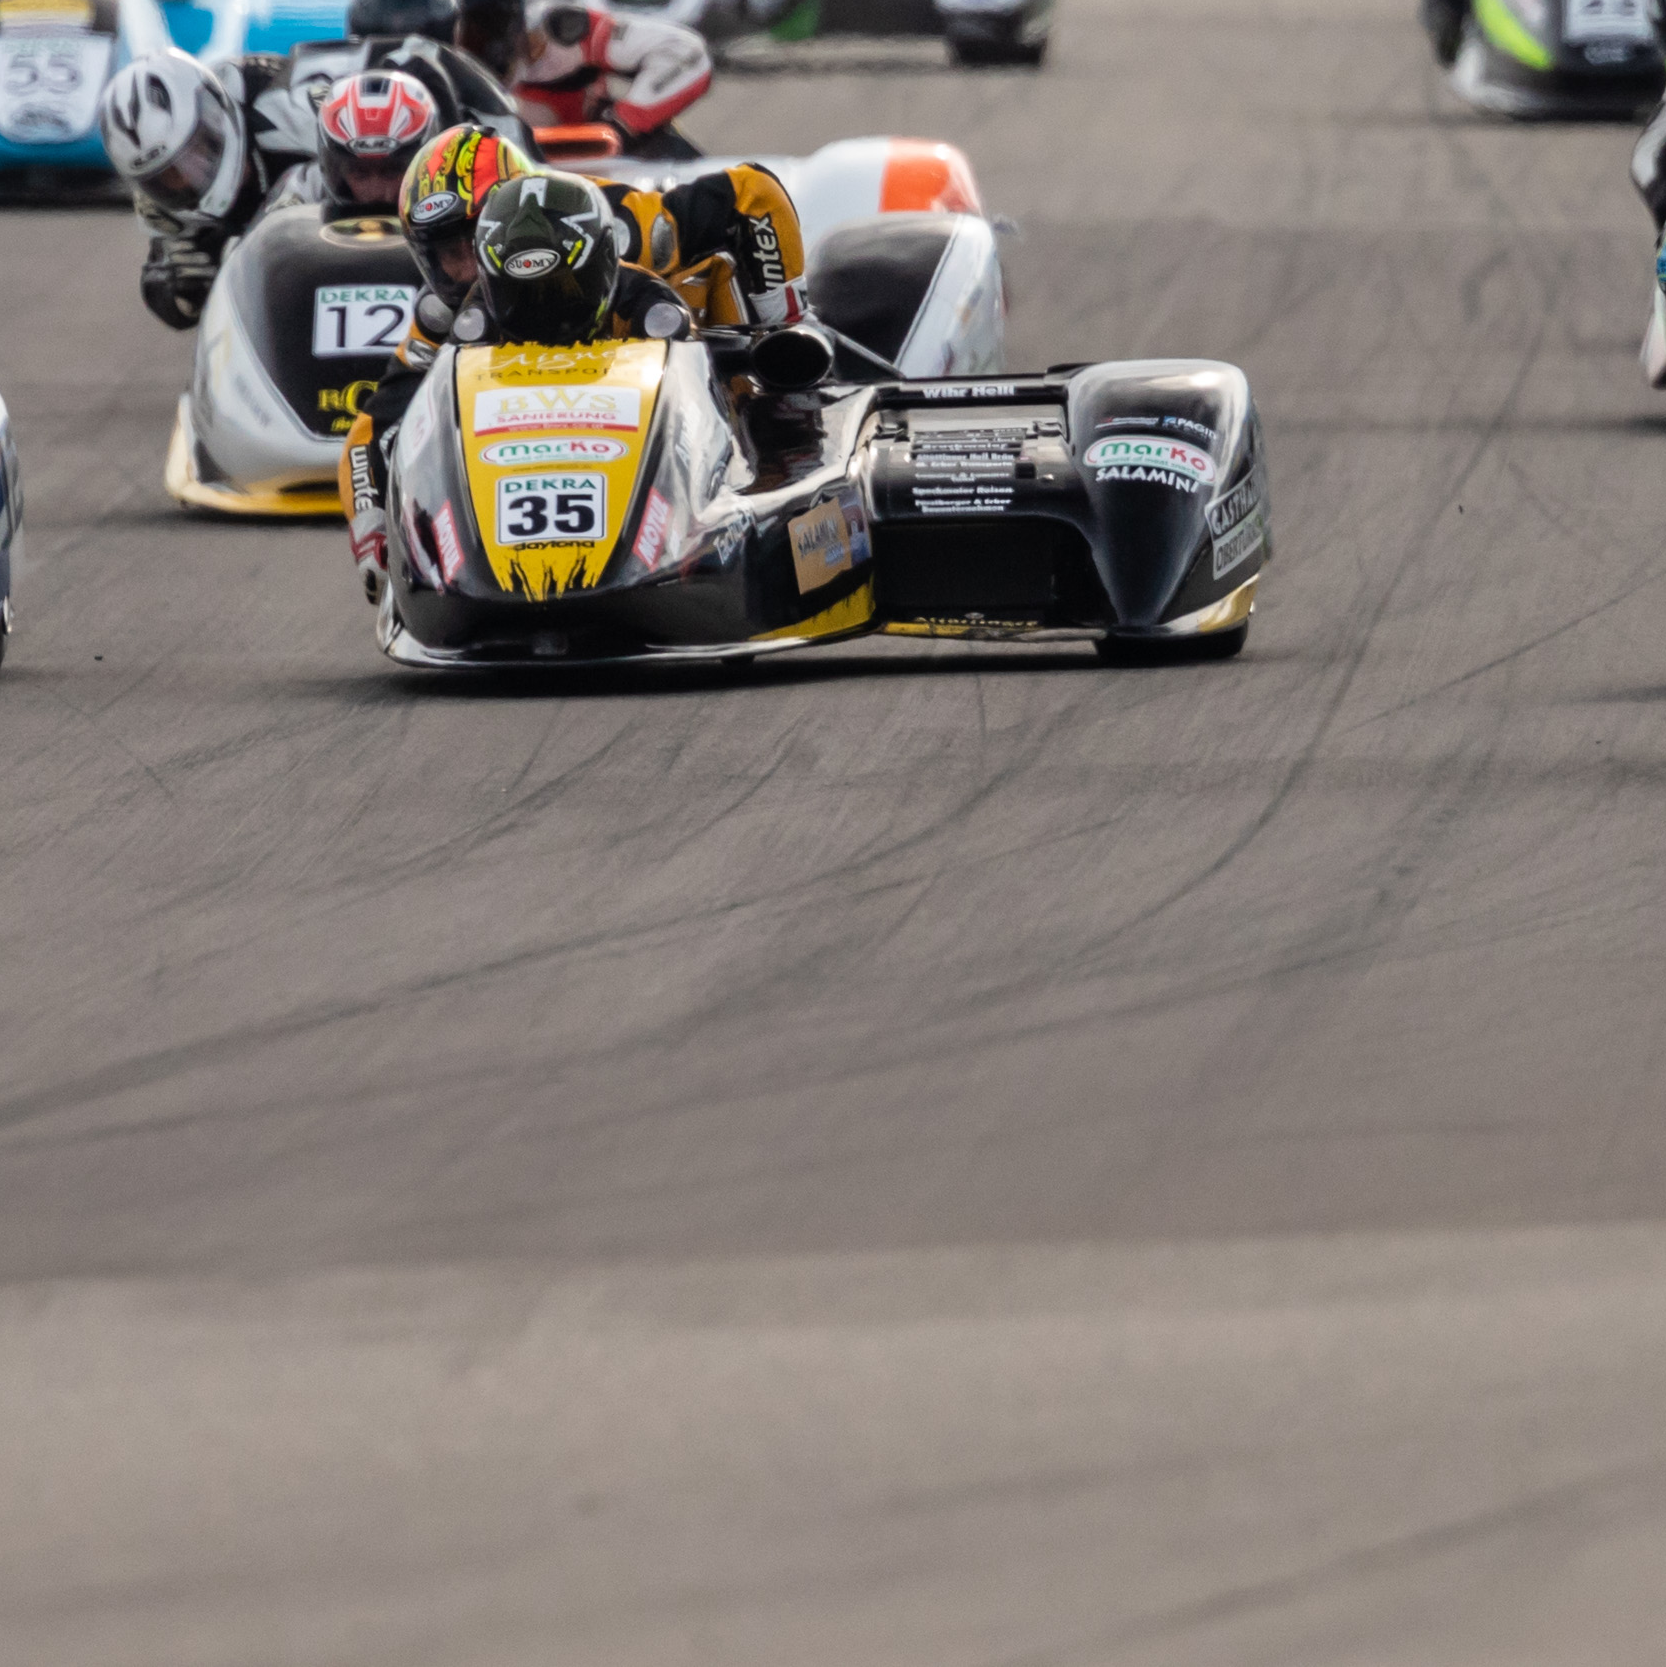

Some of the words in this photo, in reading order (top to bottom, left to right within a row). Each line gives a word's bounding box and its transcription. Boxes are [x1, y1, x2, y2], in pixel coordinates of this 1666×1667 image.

[508, 256, 555, 270] SUOMY
[320, 288, 409, 304] DEKRA
[326, 303, 405, 348] 12
[499, 388, 617, 414] BWS
[496, 411, 617, 424] SANIERUNG
[504, 477, 597, 494] DEKRA
[1095, 465, 1200, 494] SALAMINI
[506, 493, 596, 537] 35
[513, 540, 596, 552] daytona
